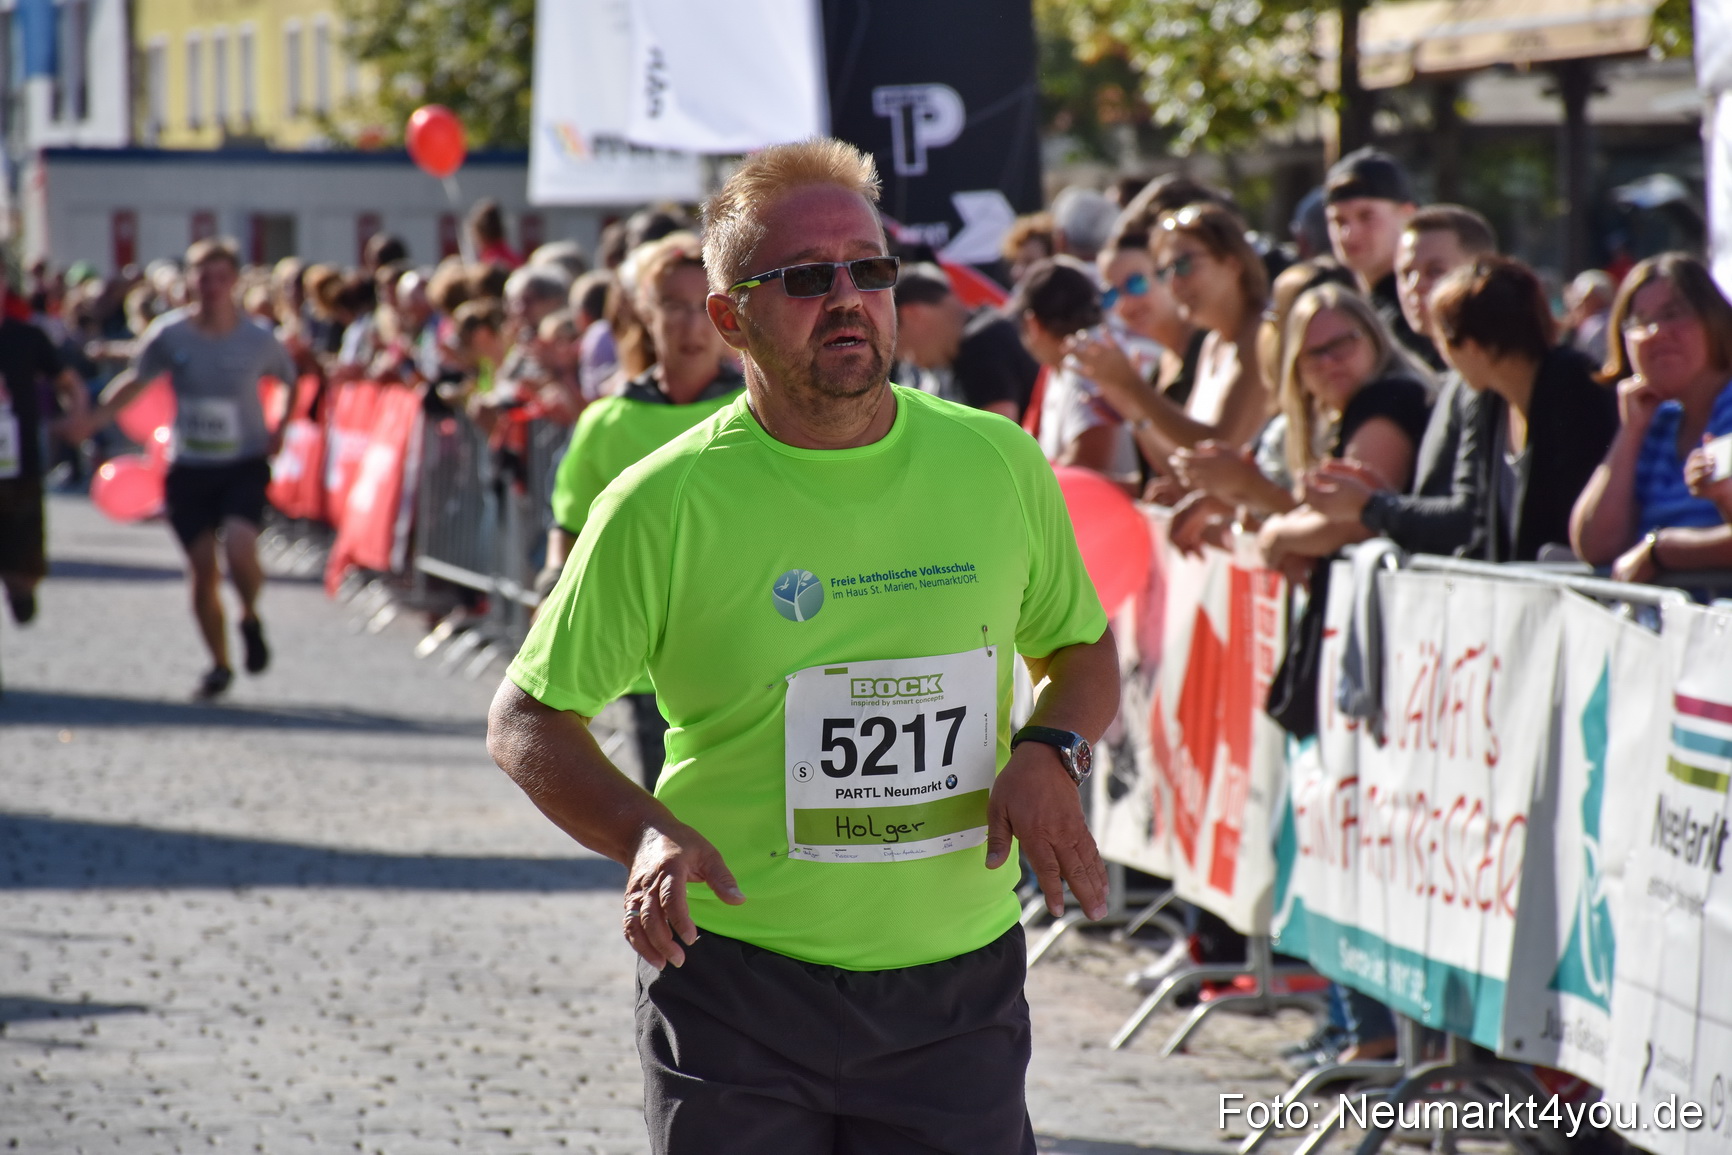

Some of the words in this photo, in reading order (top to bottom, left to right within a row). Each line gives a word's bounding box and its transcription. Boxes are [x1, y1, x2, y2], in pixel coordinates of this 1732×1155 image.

[831, 576, 857, 588] Freie
[859, 568, 918, 584] katholische
[919, 562, 976, 577] Volksschule
[832, 590, 844, 600] im
[846, 587, 868, 598] Haus
[870, 585, 882, 595] St.
[884, 581, 917, 594] Marien,
[850, 673, 944, 699] BOCK
[850, 699, 880, 708] inspired
[881, 699, 890, 707] by
[892, 697, 914, 706] smart
[915, 694, 944, 706] concepts
[820, 705, 967, 778] 5217
[799, 767, 807, 778] S
[835, 787, 881, 799] PARTL
[884, 780, 942, 798] Neumarkt
[835, 814, 926, 843] Holger
